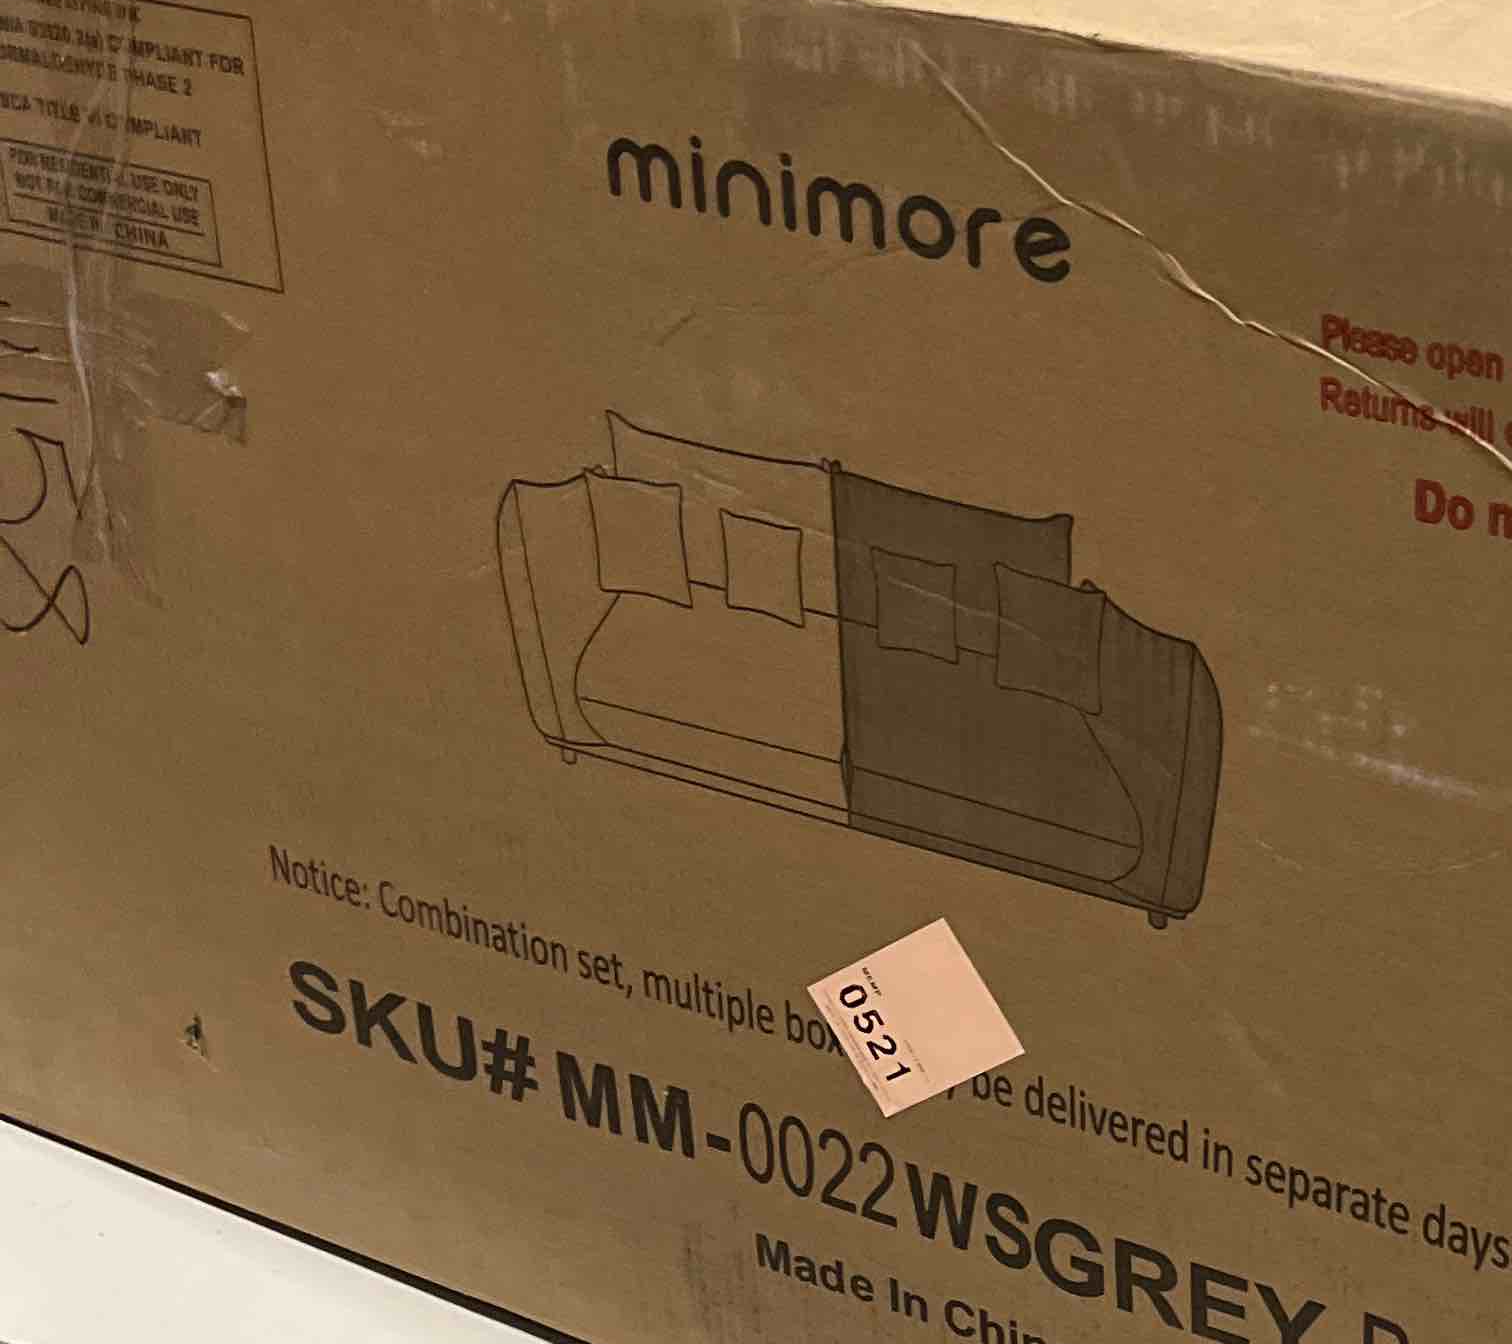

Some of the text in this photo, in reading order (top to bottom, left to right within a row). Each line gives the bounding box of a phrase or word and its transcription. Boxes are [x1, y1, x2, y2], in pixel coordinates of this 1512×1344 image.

[114, 223, 170, 249] CHINA
[607, 136, 1072, 283] minimore
[1321, 314, 1418, 365] Please
[1426, 341, 1504, 383] open
[1320, 377, 1438, 432] Returns
[1442, 404, 1495, 444] will
[1414, 479, 1475, 531] Do
[268, 844, 371, 910] Notice:
[379, 881, 570, 973] Combination
[578, 950, 634, 999] set,
[643, 966, 775, 1034] multiple
[1025, 1076, 1190, 1163] delivered
[1202, 1128, 1234, 1177] in
[1245, 1154, 1411, 1236] separate
[289, 960, 540, 1103] SKU#
[839, 984, 912, 1082] 0521
[755, 1233, 874, 1342] Made
[889, 1277, 928, 1323] In
